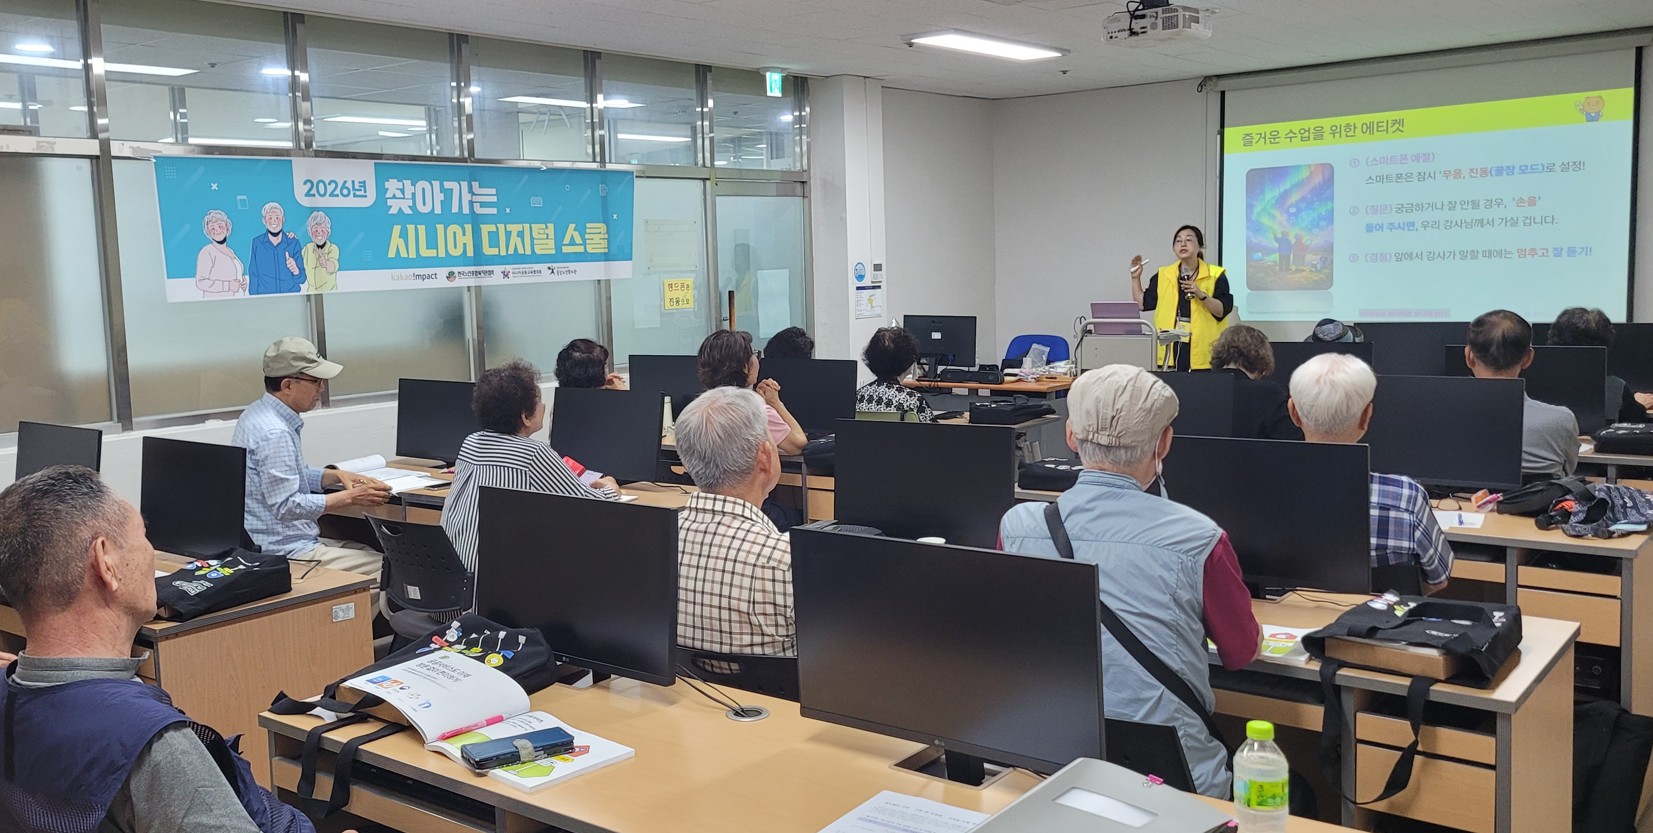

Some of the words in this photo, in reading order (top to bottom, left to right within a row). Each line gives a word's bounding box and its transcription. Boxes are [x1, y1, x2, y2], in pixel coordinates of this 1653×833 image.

[1241, 129, 1281, 147] 즐거운
[1284, 125, 1325, 143] 수업을
[1329, 122, 1358, 139] 위한
[1361, 117, 1405, 136] 에티켓
[1365, 153, 1409, 167] (스마트폰
[1365, 171, 1414, 185] 스마트폰은
[1416, 170, 1436, 182] 잠시
[1517, 162, 1557, 174] 모드)로
[1559, 160, 1586, 173] 설정!
[302, 178, 368, 199] 2026년
[384, 178, 498, 215] 찾아가는
[1394, 200, 1444, 214] 궁금하거나
[1446, 200, 1457, 211] 잘
[1459, 198, 1480, 211] 안될
[1482, 197, 1507, 210] 경우,
[1365, 222, 1384, 233] 들어
[1386, 220, 1418, 232] 주시면,
[1420, 219, 1440, 231] 우리
[1442, 217, 1495, 230] 강사님께서
[1497, 215, 1519, 228] 가실
[1522, 214, 1559, 227] 겁니다.
[387, 223, 474, 259] 시니어
[480, 222, 556, 256] 디지털
[561, 222, 609, 254] 스쿨
[1394, 250, 1423, 262] 앞에서
[1425, 249, 1456, 261] 강사가
[1458, 248, 1479, 261] 말할
[1481, 247, 1514, 260] 때에는
[1516, 247, 1549, 259] 멈추고
[1552, 246, 1564, 258] 잘
[1566, 246, 1592, 258] 듣기!
